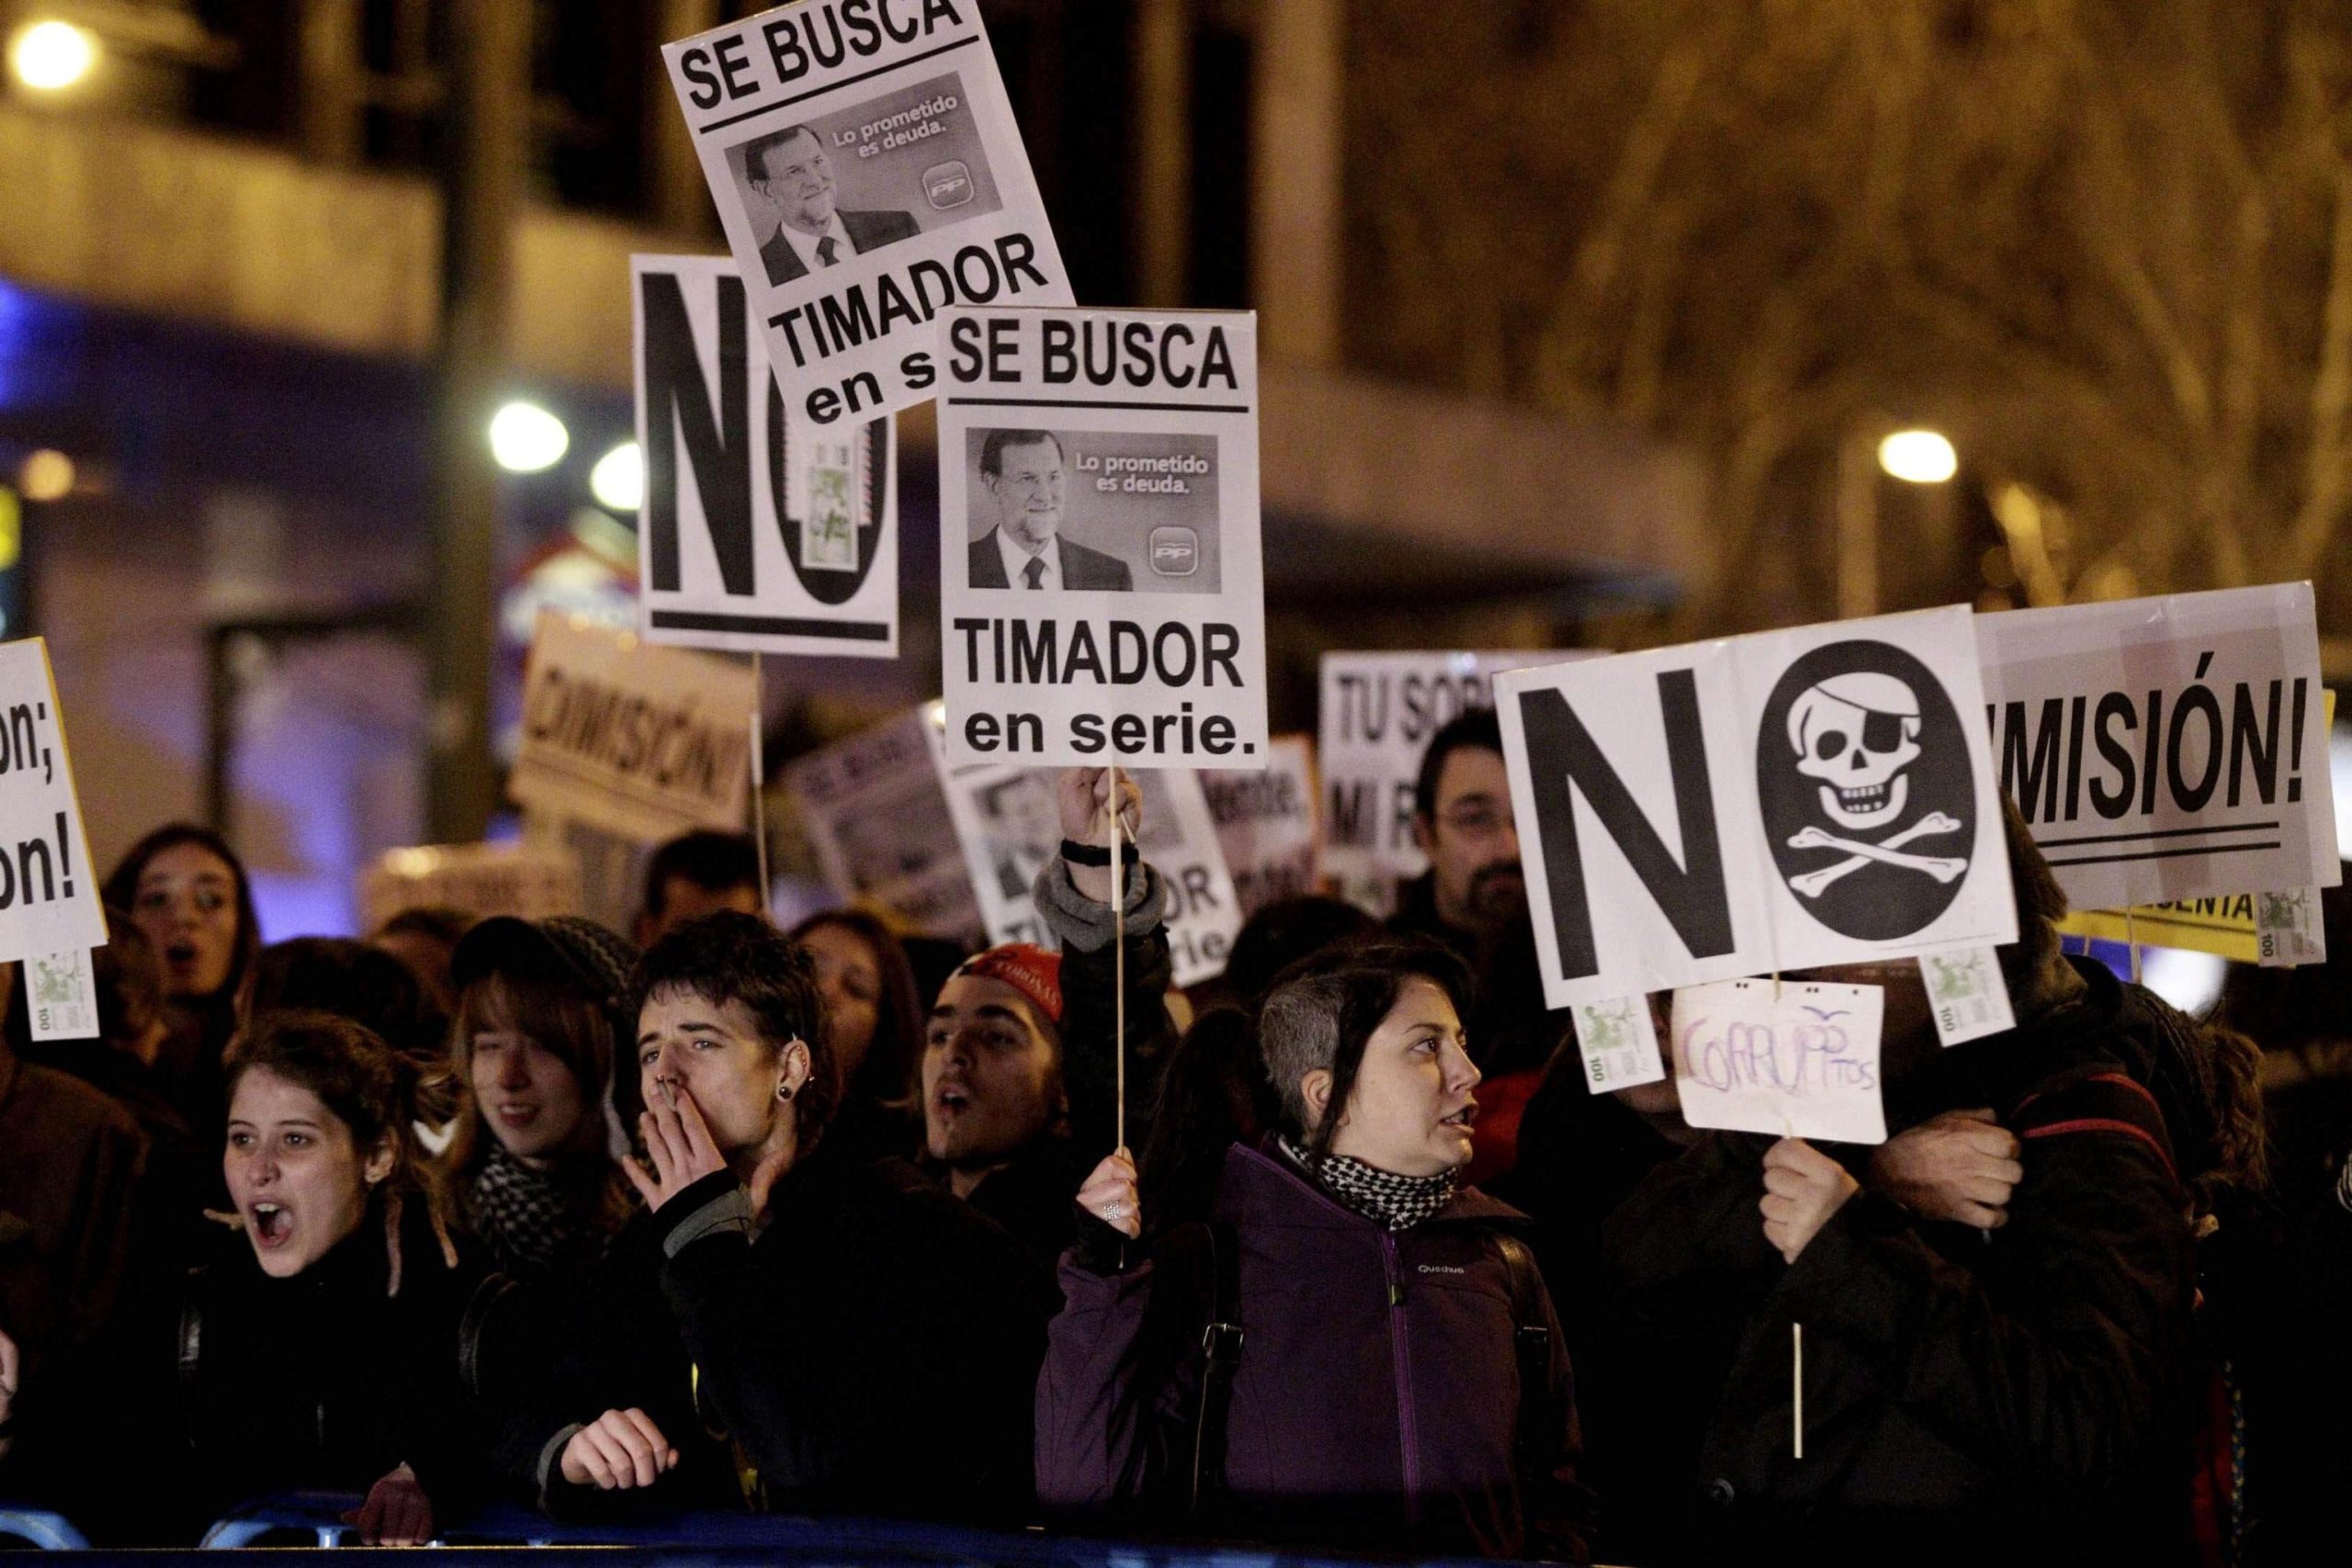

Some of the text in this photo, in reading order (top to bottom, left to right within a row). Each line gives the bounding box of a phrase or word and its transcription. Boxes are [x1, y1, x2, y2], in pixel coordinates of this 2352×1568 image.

[681, 0, 963, 109] SE BUSCA
[831, 96, 957, 147] Lo prometido
[858, 120, 947, 157] es deuda.
[767, 232, 1049, 367] TIMADOR
[949, 318, 1238, 389] SE BUSCA
[806, 371, 884, 424] en
[1076, 453, 1208, 475] Lo prometido
[1096, 474, 1191, 494] es deuda.
[954, 618, 1244, 688] TIMADOR
[965, 703, 1256, 755] en serie.
[1518, 639, 1976, 981] NO
[38, 1008, 51, 1031] 100
[1939, 1007, 1956, 1032] 100
[1589, 1057, 1605, 1083] 100
